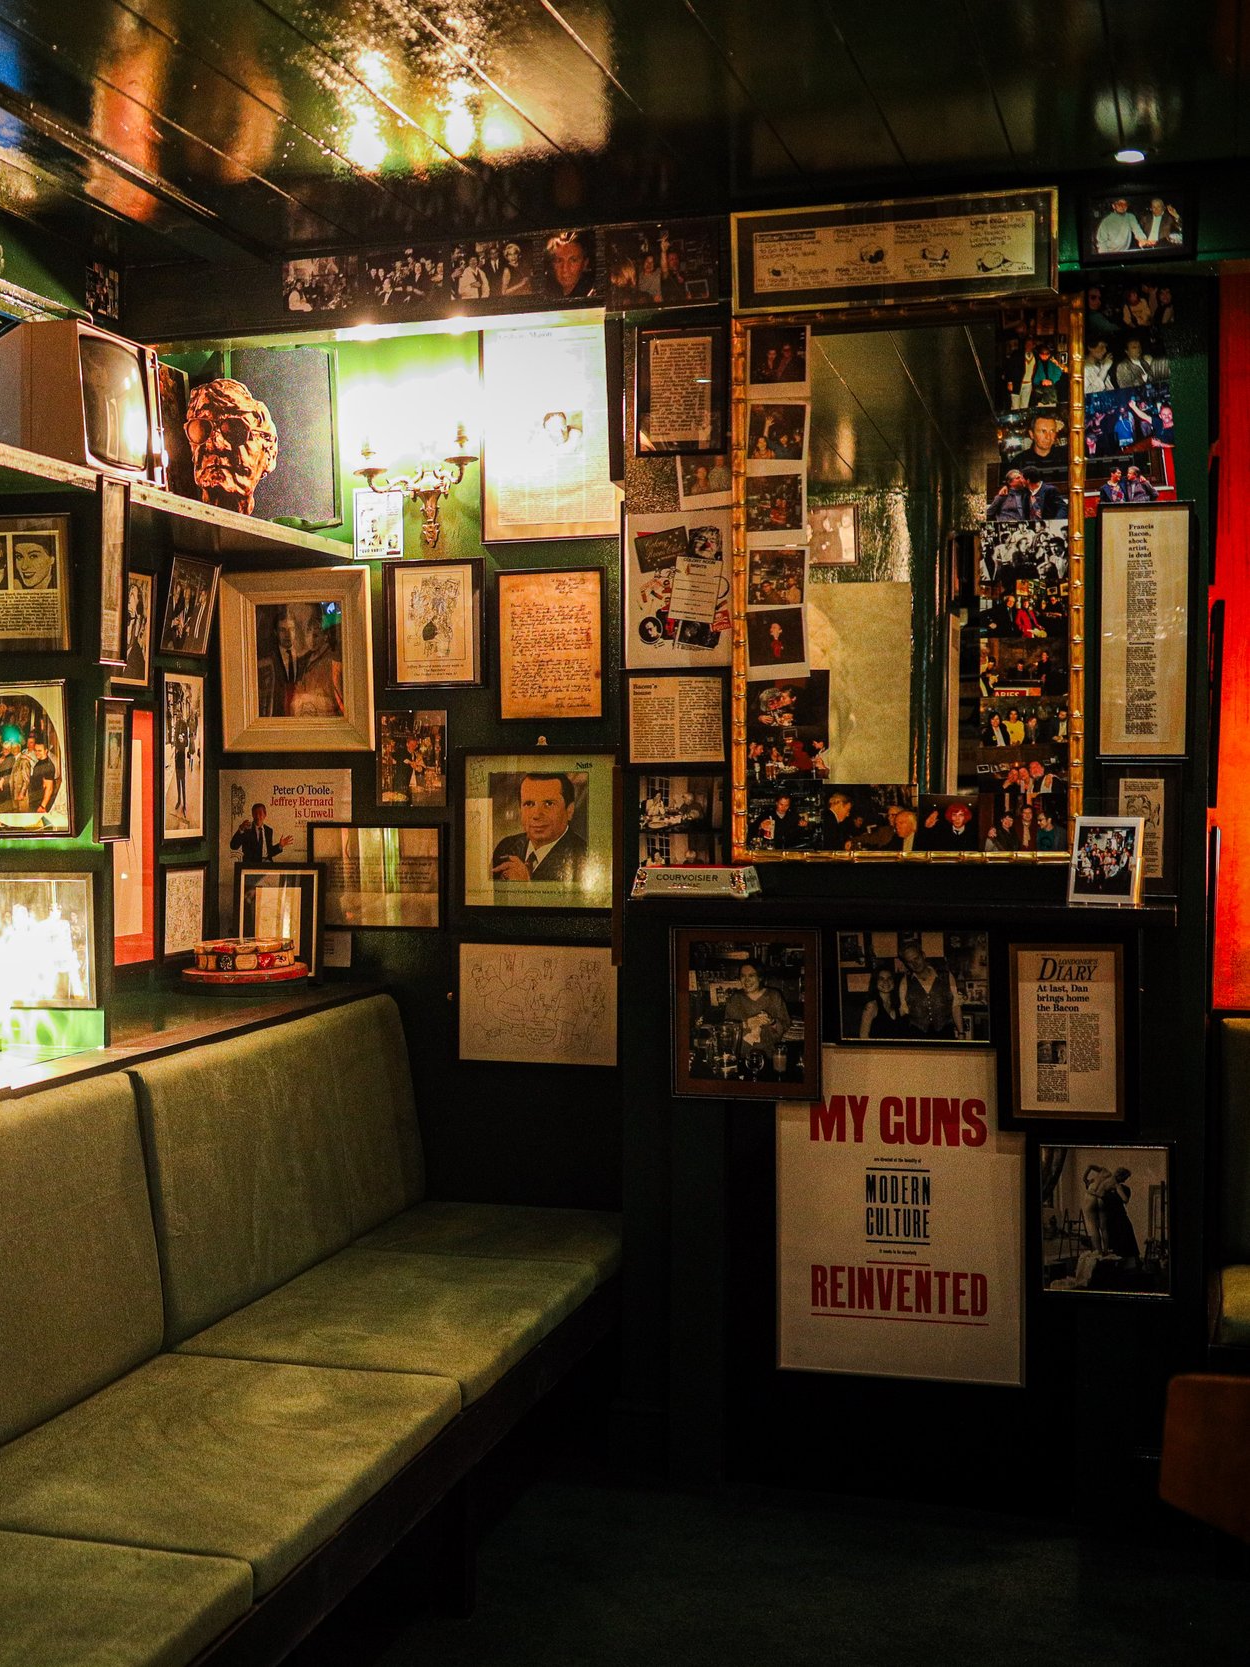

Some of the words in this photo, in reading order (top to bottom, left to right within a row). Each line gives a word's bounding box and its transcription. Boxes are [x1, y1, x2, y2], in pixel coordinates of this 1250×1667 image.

[273, 785, 295, 795] Peter
[297, 783, 330, 795] O'Toole
[270, 796, 299, 808] Jeffrey
[299, 796, 334, 807] Bernard
[295, 808, 302, 818] is
[303, 808, 334, 818] Unwell
[656, 874, 719, 882] COURVOISIER
[1037, 957, 1098, 981] DIARY
[1049, 984, 1068, 993] last,
[1071, 984, 1088, 992] Dan
[1037, 994, 1064, 1003] brings
[1066, 994, 1090, 1002] home
[1037, 1003, 1051, 1012] the
[1053, 1003, 1079, 1012] Bacon
[810, 1095, 869, 1143] MY
[880, 1096, 988, 1147] GUNS
[866, 1174, 930, 1205] MODERN
[866, 1207, 930, 1238] CULTURE
[811, 1264, 988, 1317] REINVENTED
